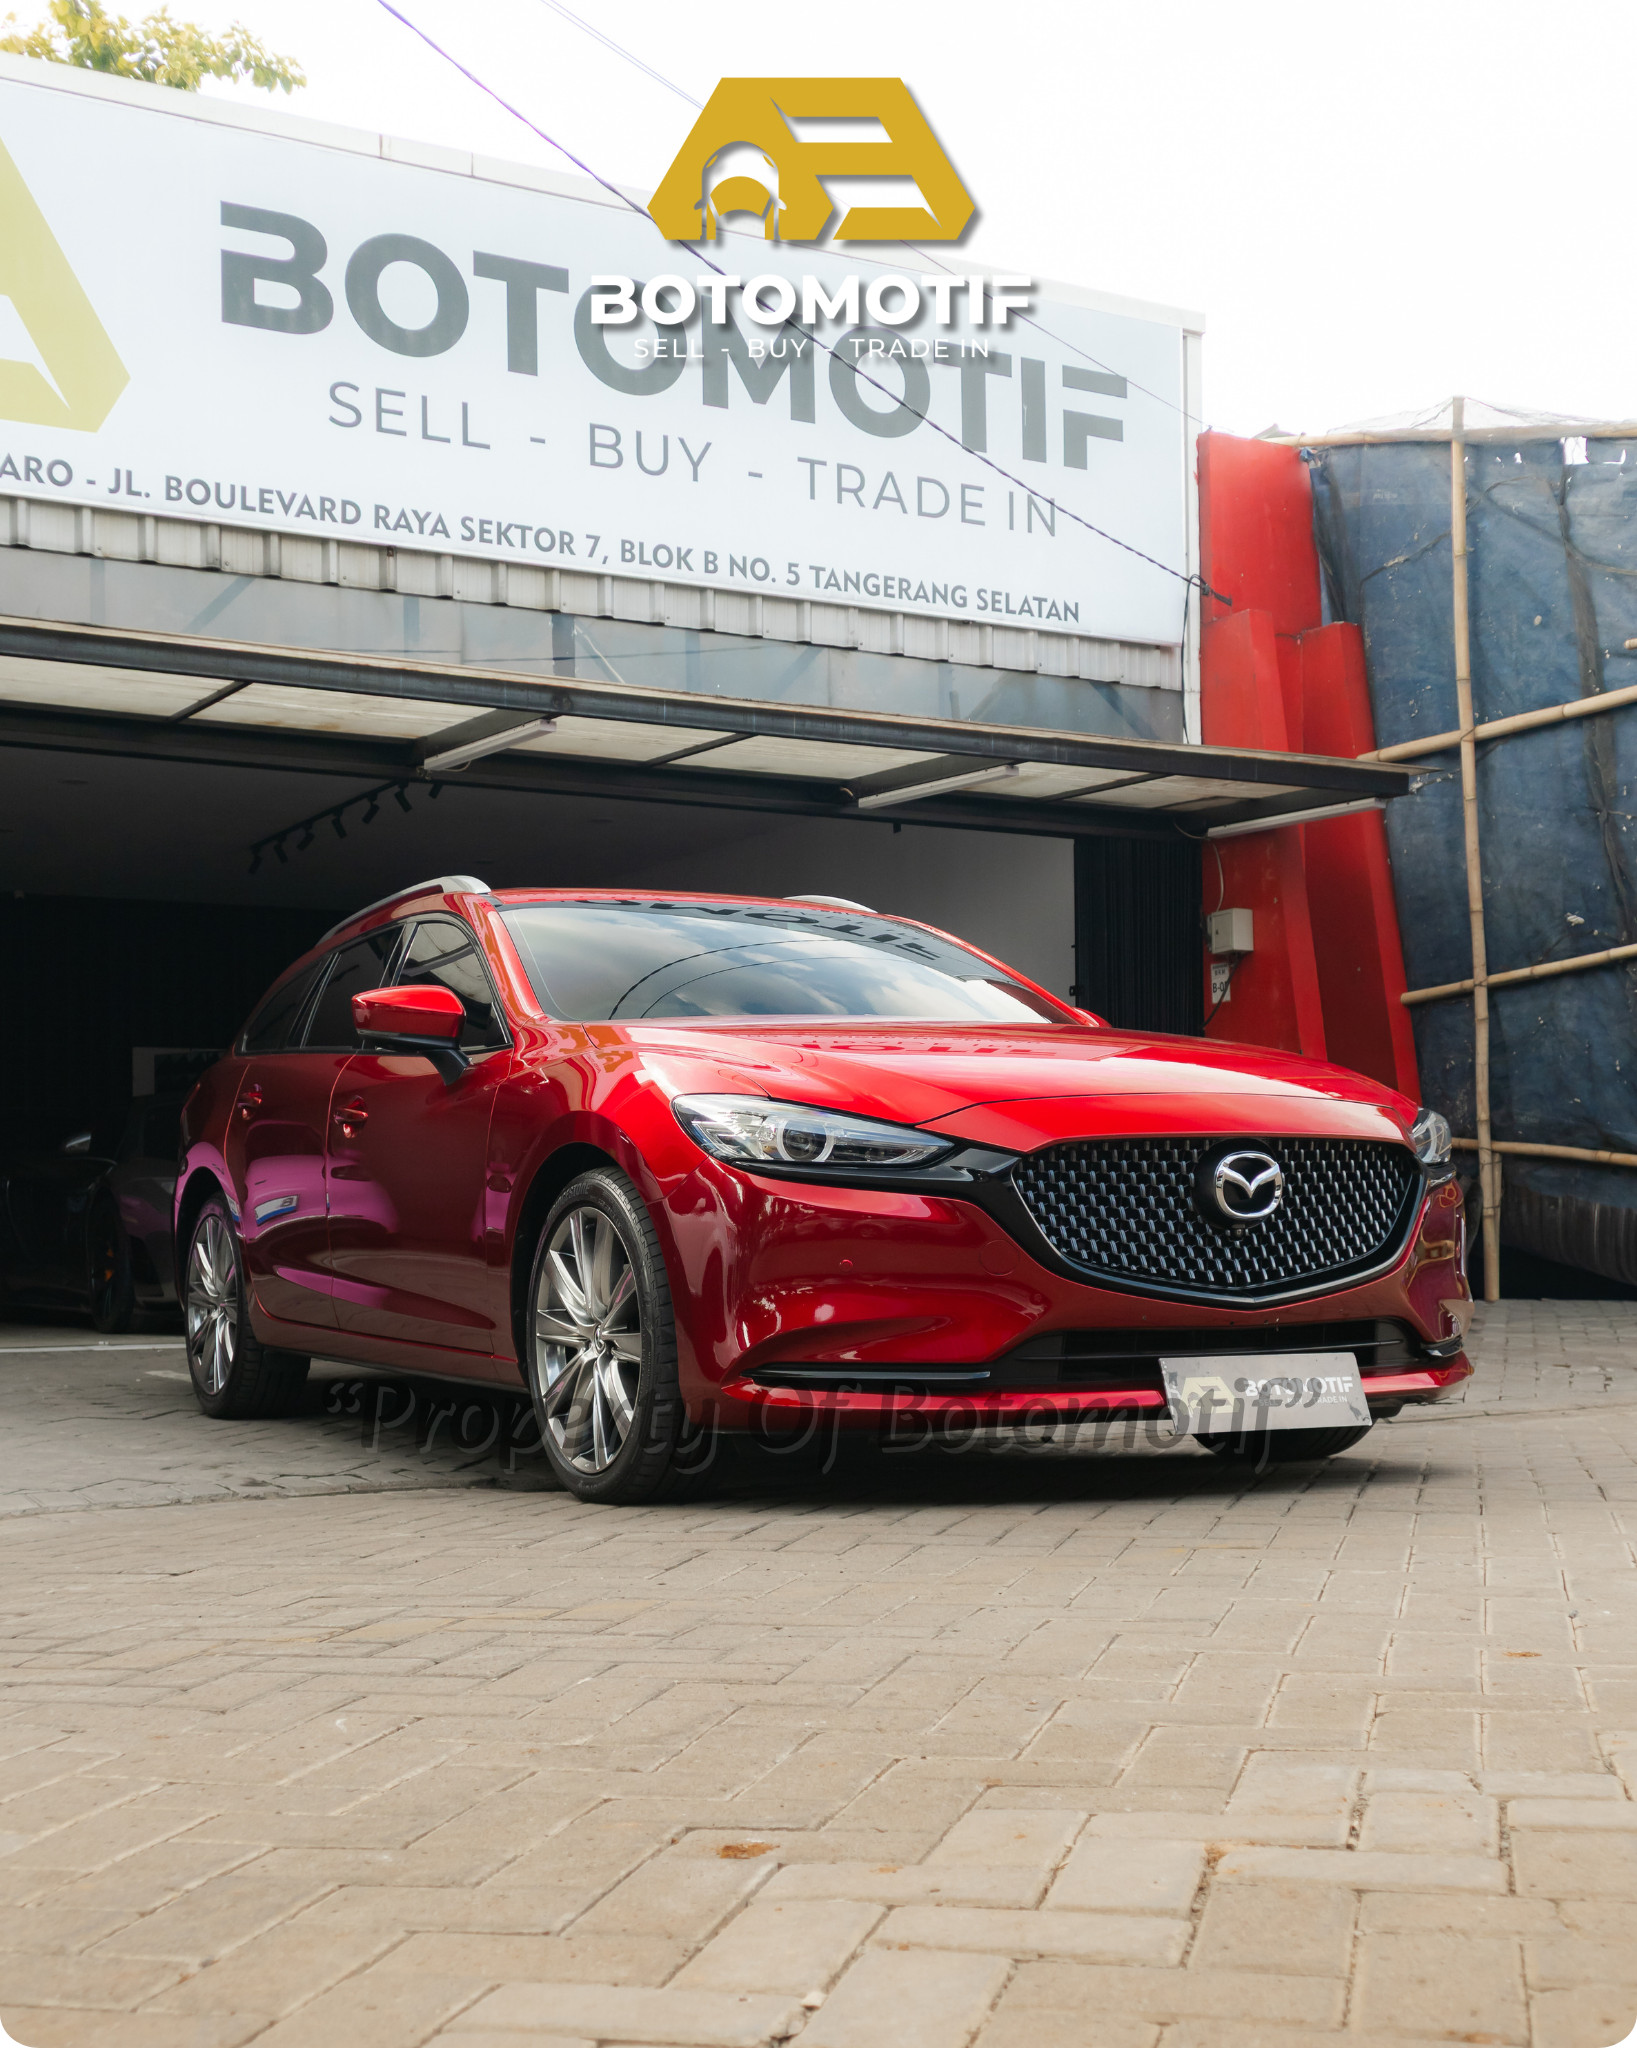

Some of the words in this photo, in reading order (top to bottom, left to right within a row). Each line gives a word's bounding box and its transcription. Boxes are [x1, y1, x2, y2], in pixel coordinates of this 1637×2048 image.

[221, 201, 1127, 470] BOTOMOTIF
[0, 453, 73, 487] ARO
[108, 468, 151, 499] JL.
[165, 474, 362, 525] BOULEVARD
[374, 503, 451, 539] RAYA
[460, 516, 576, 556] SEKTOR
[585, 534, 609, 565] 7,
[620, 539, 695, 572] BLOK
[704, 550, 719, 574] B
[729, 553, 777, 584] NO.
[786, 562, 801, 586] 5
[809, 565, 969, 609] TANGERANG
[976, 588, 1080, 624] SELATAN
[328, 381, 491, 450] SELL
[589, 422, 713, 482] BUY
[797, 456, 986, 527] TRADE
[1007, 490, 1056, 538] IN
